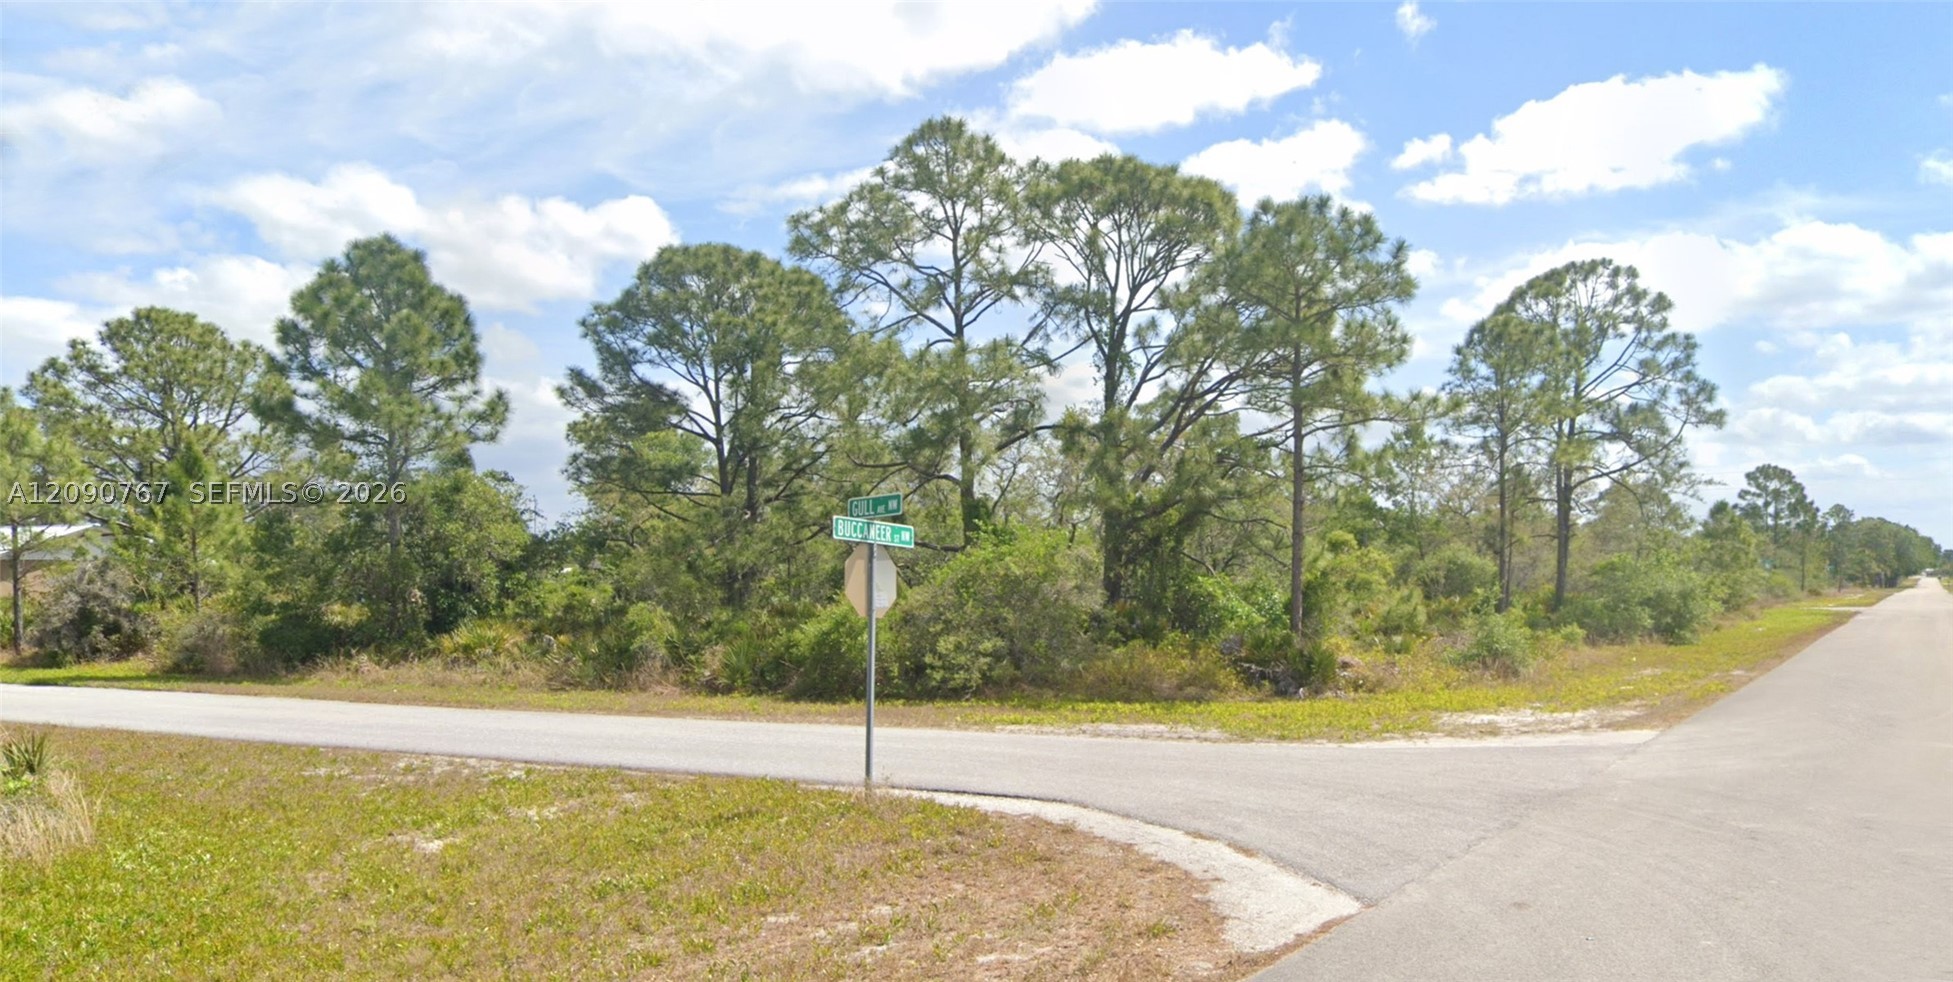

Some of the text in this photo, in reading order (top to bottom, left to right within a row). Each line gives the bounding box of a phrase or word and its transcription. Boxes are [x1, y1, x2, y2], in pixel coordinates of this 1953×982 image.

[852, 499, 875, 516] GULL
[888, 499, 898, 510] NW
[837, 520, 892, 542] BUCCANEER
[901, 531, 910, 542] NW
